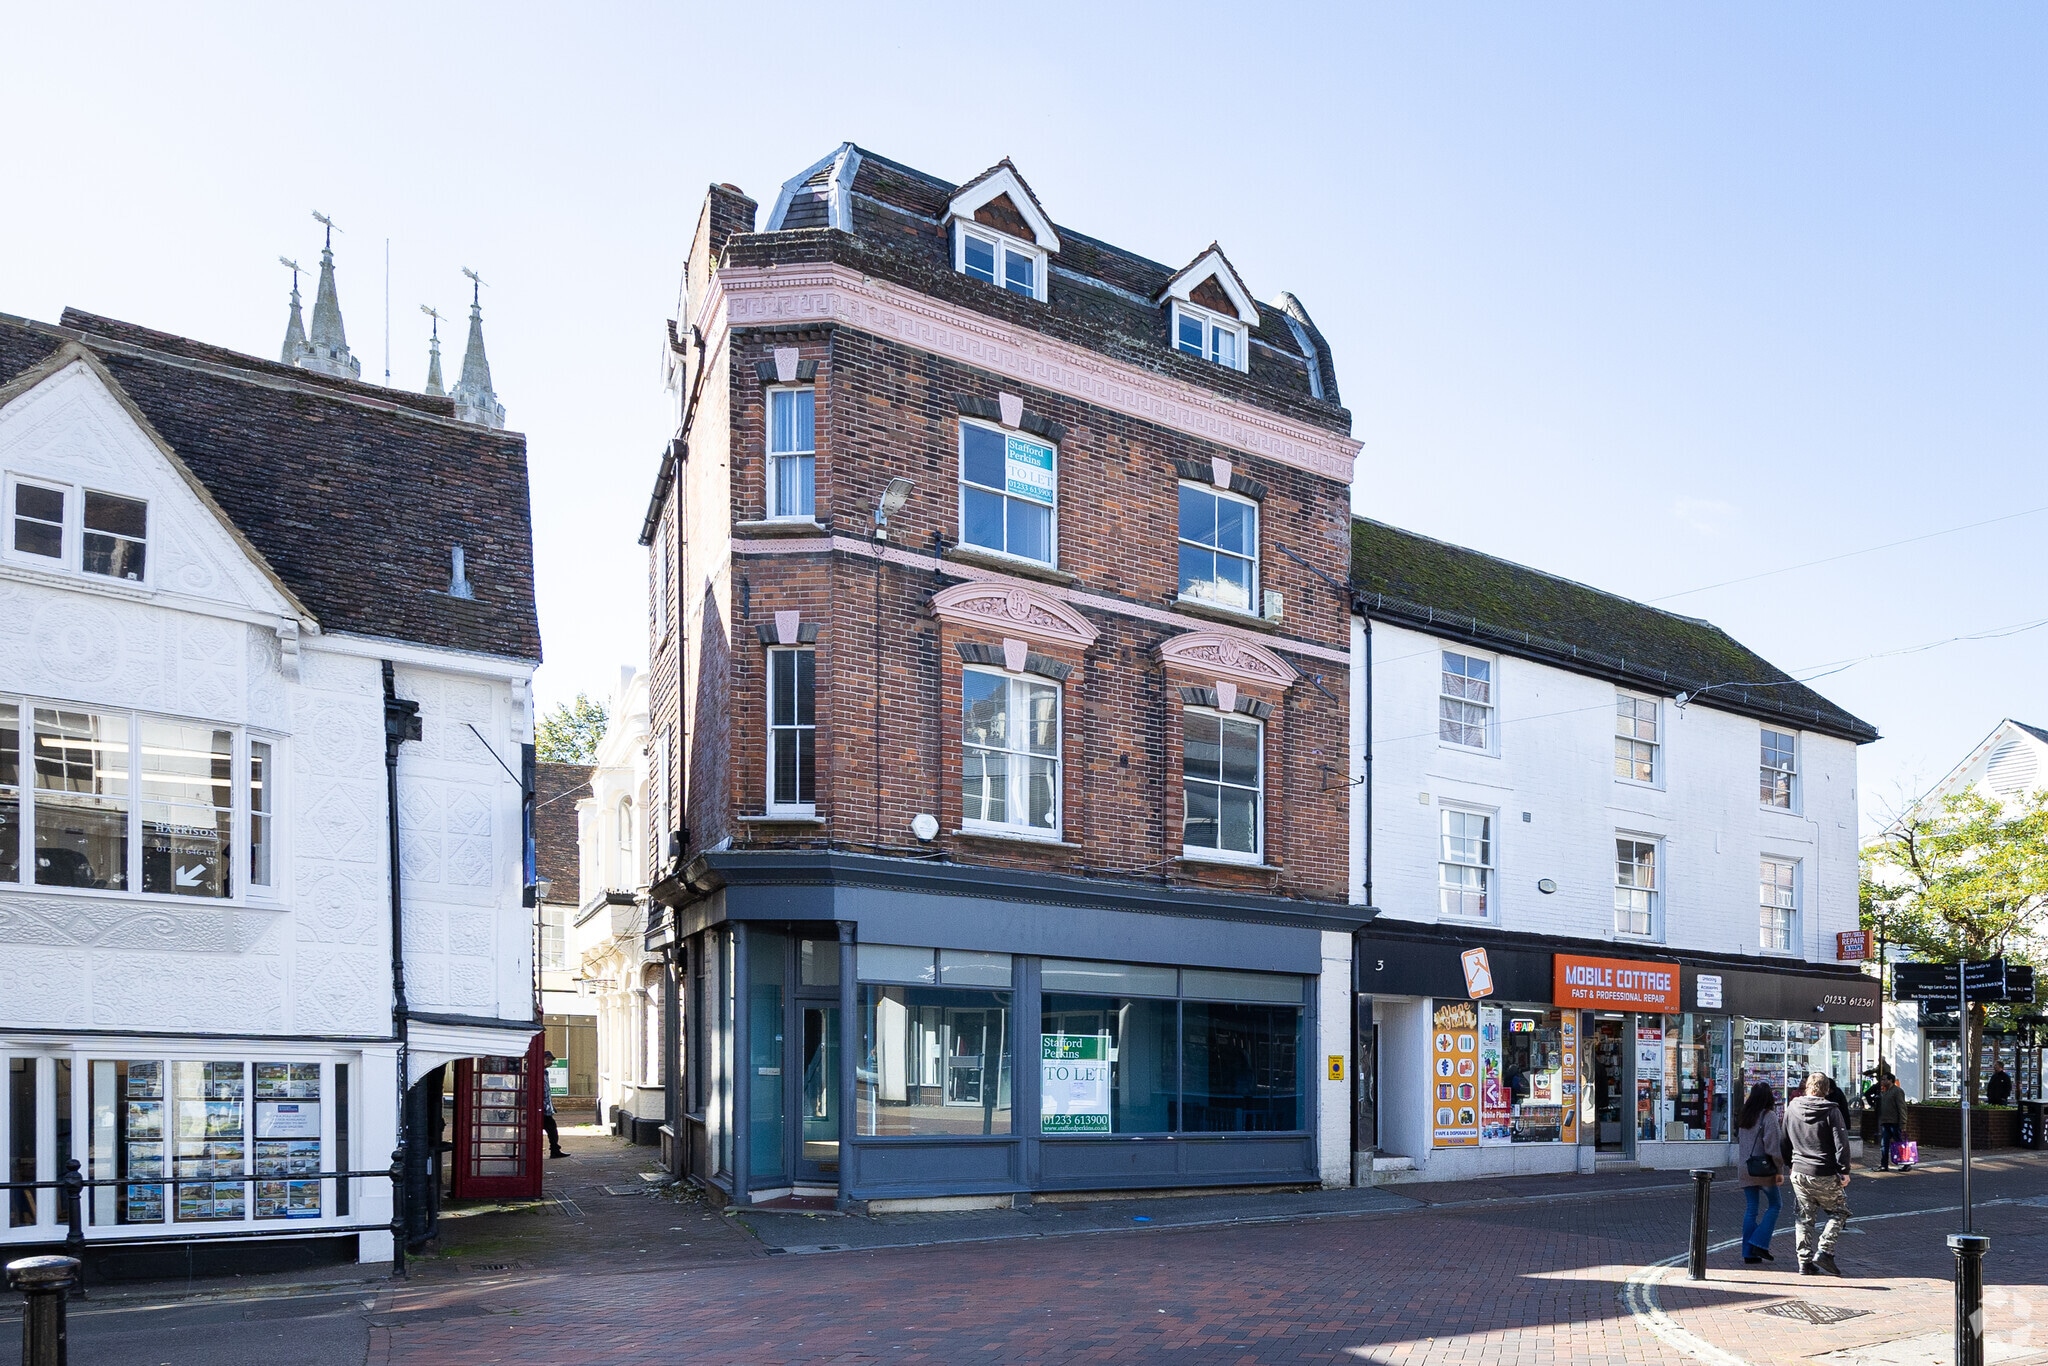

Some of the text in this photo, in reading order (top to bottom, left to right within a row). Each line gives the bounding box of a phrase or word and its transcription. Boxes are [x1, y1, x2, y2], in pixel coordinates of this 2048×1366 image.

[1009, 440, 1044, 457] Stafford
[1010, 450, 1040, 466] Perkins
[1008, 466, 1052, 486] TO LET
[1008, 480, 1028, 491] 01233
[156, 825, 217, 837] HARRISON
[1842, 937, 1864, 945] REPAIR
[1375, 960, 1384, 971] 3
[1566, 966, 1671, 991] MOBILE COTTAGE
[1572, 989, 1664, 1003] FAST & PROFESSIONAL REPAIR
[1824, 995, 1874, 1007] 01233 612361
[1441, 1002, 1470, 1017] Vape
[1443, 1016, 1467, 1030] Shop
[1510, 1021, 1534, 1032] REPAIR
[1044, 1038, 1082, 1047] Stafford
[1044, 1049, 1079, 1058] Perkins
[1044, 1067, 1106, 1081] TO LET
[1044, 1116, 1108, 1124] 01233 613900
